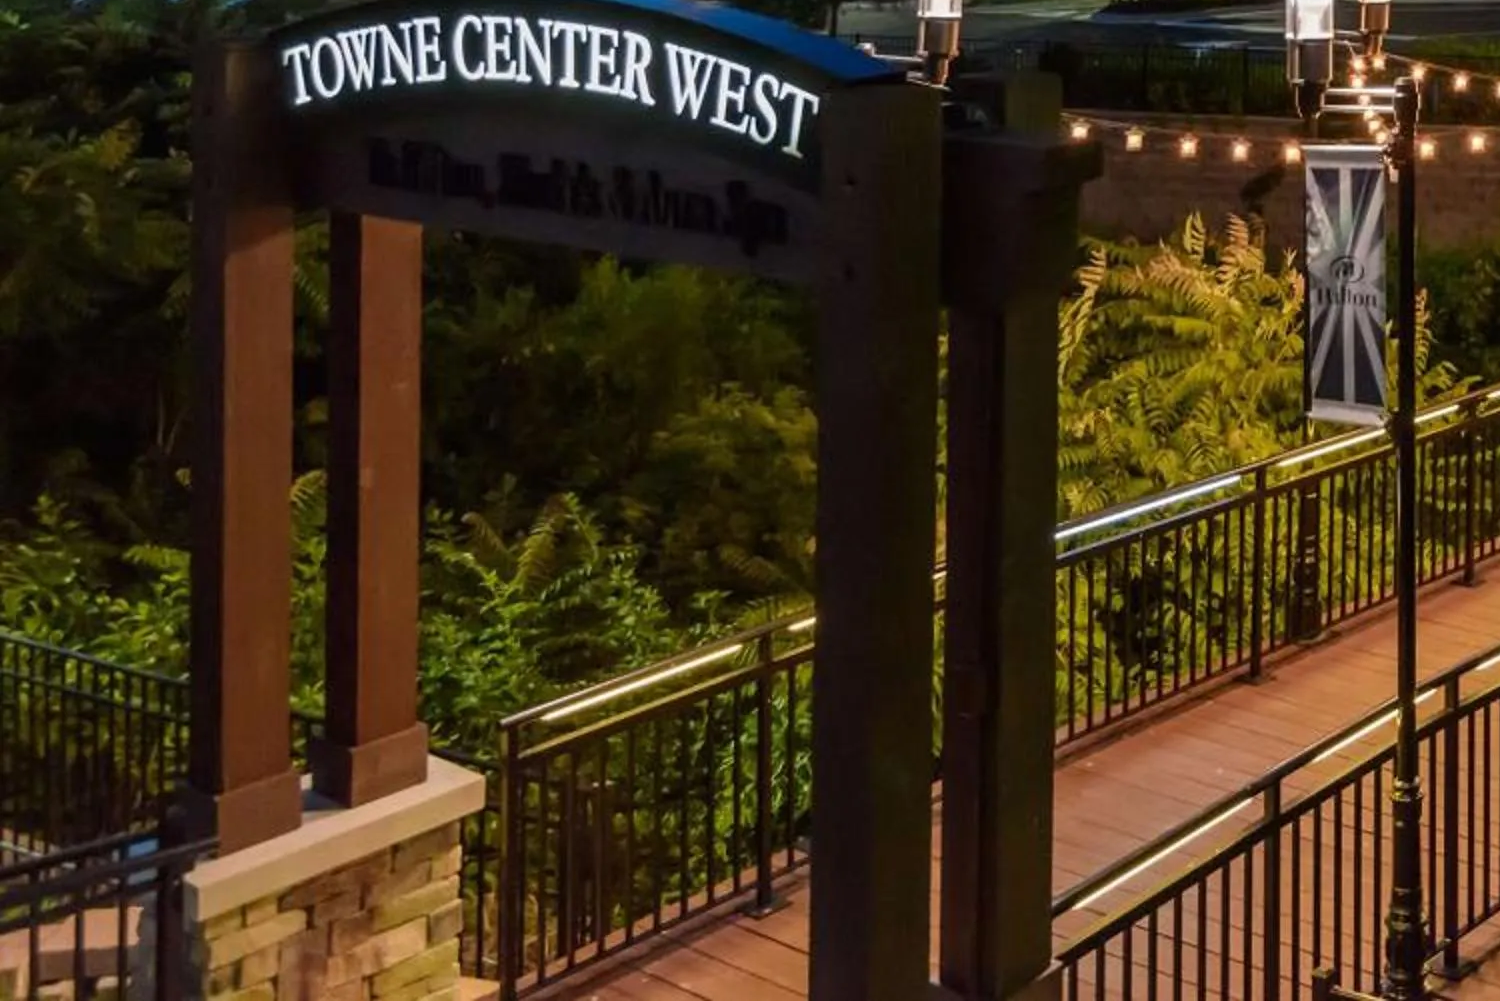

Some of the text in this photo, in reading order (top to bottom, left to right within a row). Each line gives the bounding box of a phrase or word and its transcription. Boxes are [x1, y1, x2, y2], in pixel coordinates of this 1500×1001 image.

[283, 13, 820, 158] TOWNE CENTER WEST
